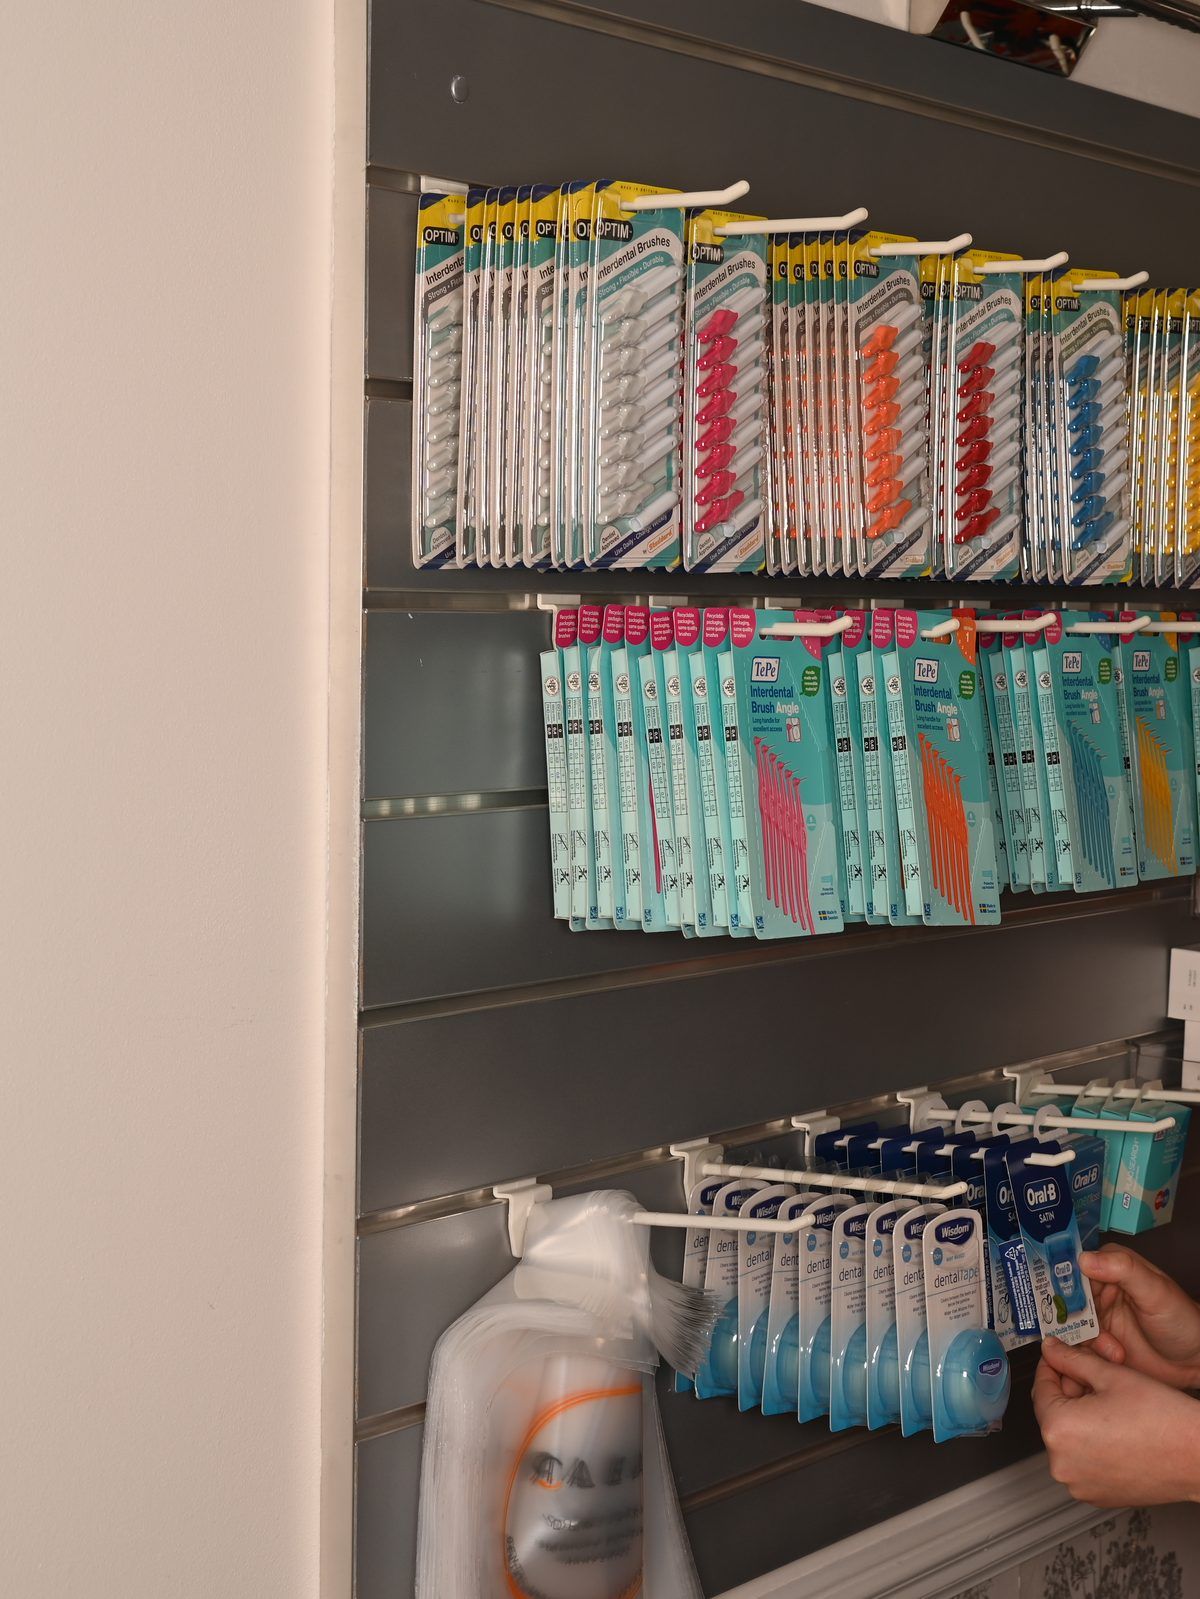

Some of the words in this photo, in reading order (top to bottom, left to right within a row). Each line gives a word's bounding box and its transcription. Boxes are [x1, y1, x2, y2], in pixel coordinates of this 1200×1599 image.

[425, 230, 456, 244] OPTIM
[598, 224, 630, 239] OPTIM
[598, 246, 636, 280] Interdental
[638, 236, 670, 254] Brushes
[693, 246, 721, 262] OPTIM
[855, 263, 877, 276] OPTIM
[694, 271, 727, 300] Interdental
[727, 258, 756, 276] Brushes
[428, 286, 447, 300] Strong
[856, 286, 886, 314] Interdental
[886, 276, 910, 292] Brushes
[986, 297, 1012, 313] Brushes
[622, 540, 634, 550] Daily
[1064, 656, 1080, 669] TePe
[1134, 654, 1148, 668] TePe
[755, 662, 776, 677] TePe
[917, 662, 936, 678] TePe
[1062, 676, 1094, 686] Interdental
[1132, 674, 1160, 684] Interdental
[750, 686, 794, 698] Interdental
[914, 686, 952, 700] Interdental
[1064, 690, 1080, 700] Brush
[1081, 690, 1098, 702] Angle
[1134, 688, 1148, 698] Brush
[1148, 687, 1164, 698] Angle
[752, 701, 774, 714] Brush
[776, 702, 800, 716] Angle
[916, 701, 936, 713] Brush
[936, 702, 958, 716] Angle
[1074, 1167, 1098, 1190] Oral-B
[1027, 1183, 1056, 1206] Oral-B
[1039, 1211, 1055, 1223] SATIN
[942, 1224, 969, 1238] Wisdom
[746, 1248, 772, 1268] dental
[839, 1264, 865, 1282] dental
